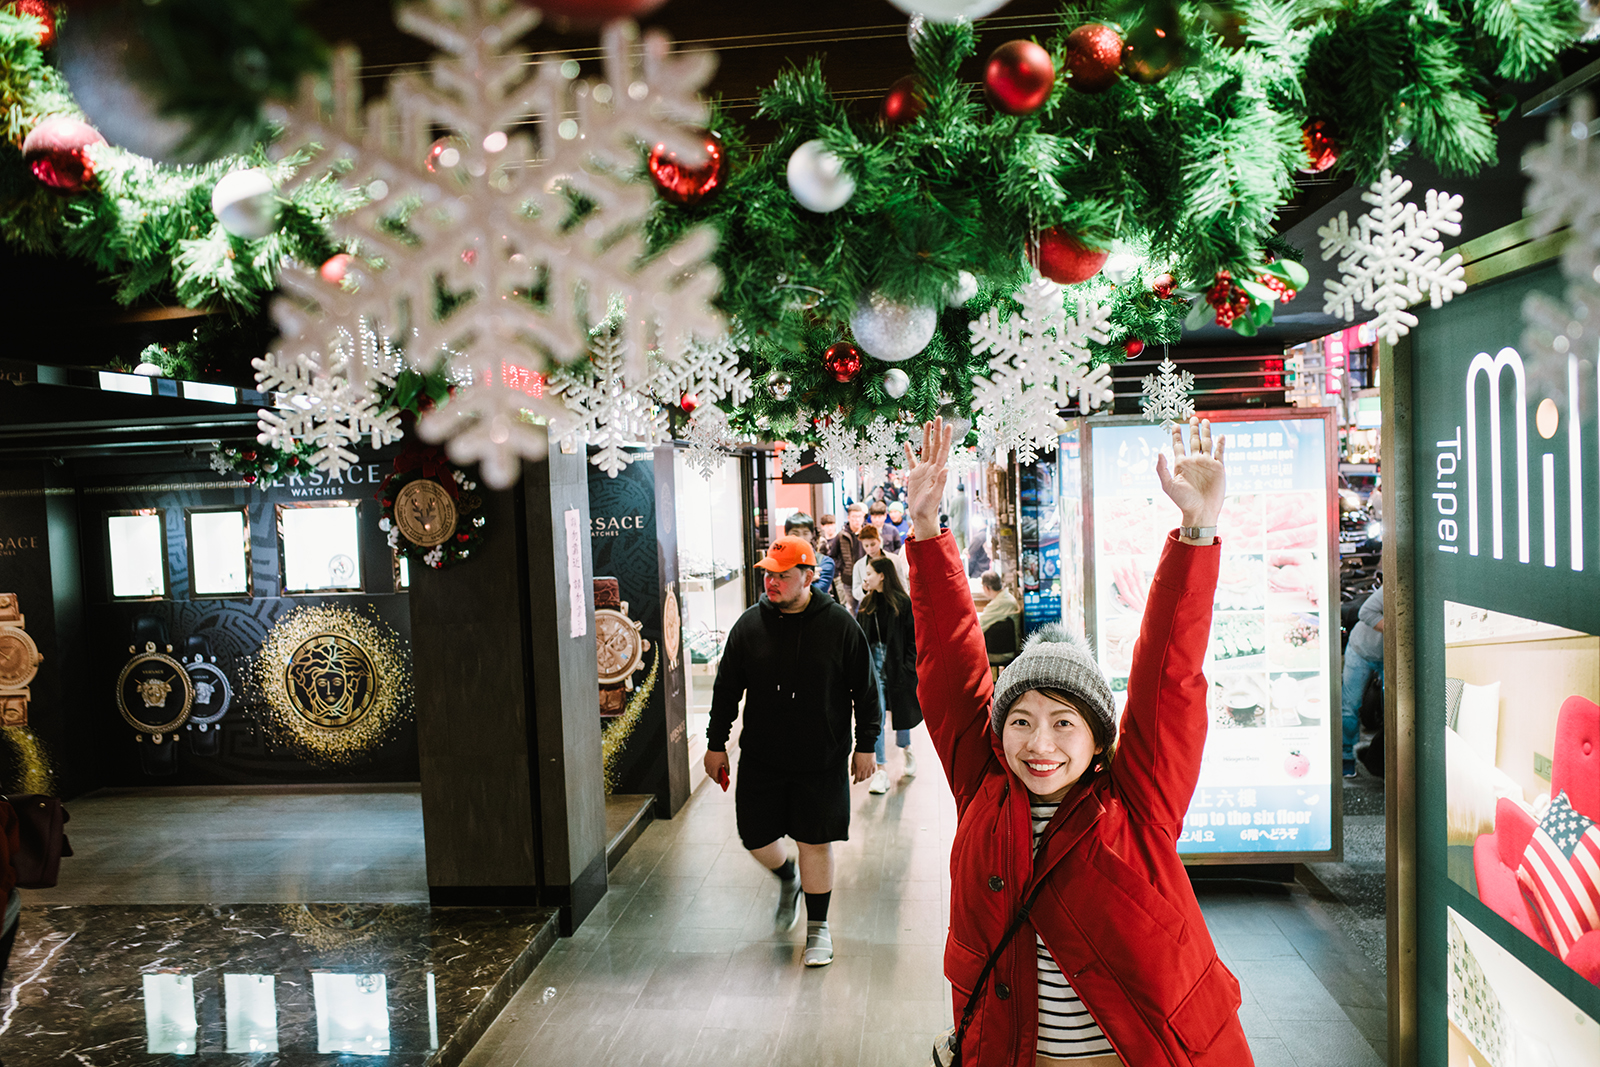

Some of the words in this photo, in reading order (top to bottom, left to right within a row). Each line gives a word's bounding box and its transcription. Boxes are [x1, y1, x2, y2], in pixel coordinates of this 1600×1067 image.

[290, 487, 344, 497] WATCHES
[1432, 426, 1461, 554] Taipei
[1189, 813, 1208, 828] up
[1210, 811, 1225, 826] to
[1227, 810, 1251, 826] the
[1253, 809, 1275, 826] six
[1276, 809, 1312, 825] floor
